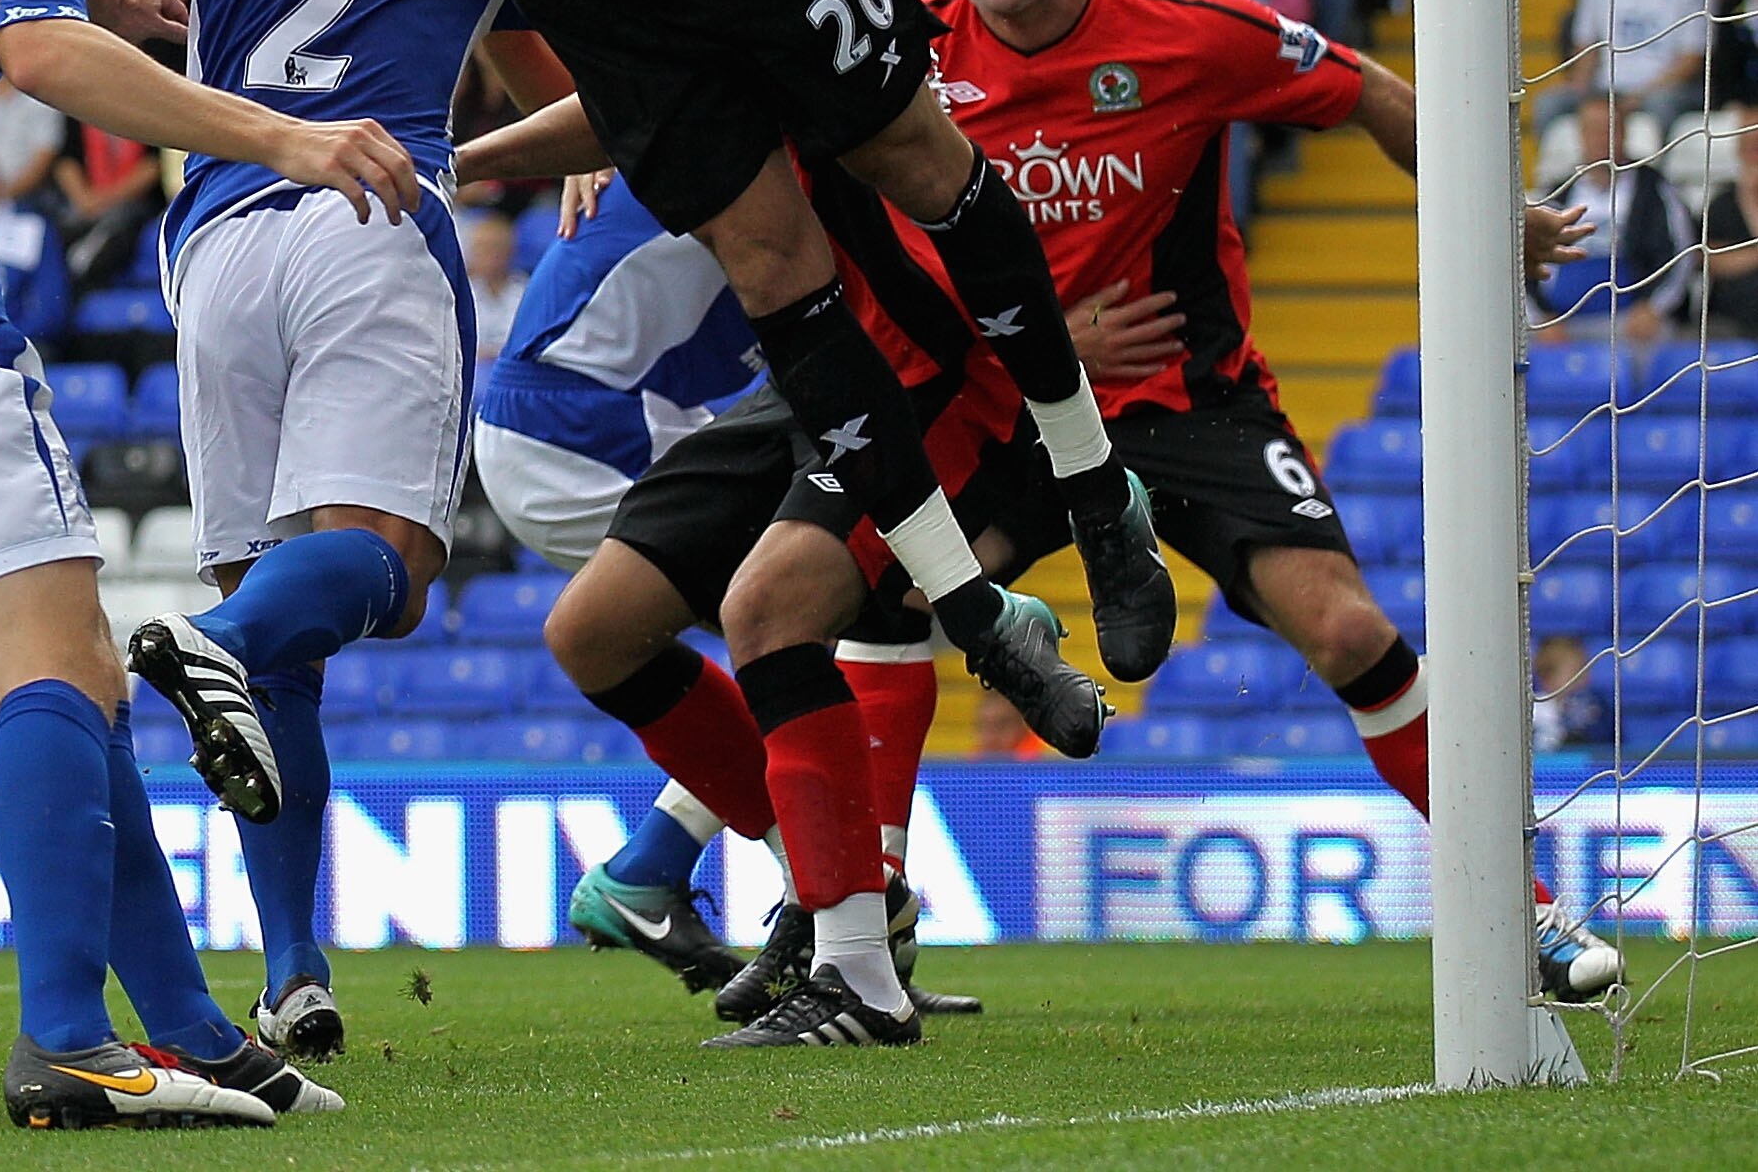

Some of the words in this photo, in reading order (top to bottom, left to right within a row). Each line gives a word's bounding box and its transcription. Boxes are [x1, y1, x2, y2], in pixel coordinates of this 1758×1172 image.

[989, 151, 1144, 202] ROWN
[1028, 198, 1104, 225] INTS
[1263, 438, 1316, 498] 6
[1089, 828, 1378, 940] FOR
[1530, 825, 1758, 935] EN
